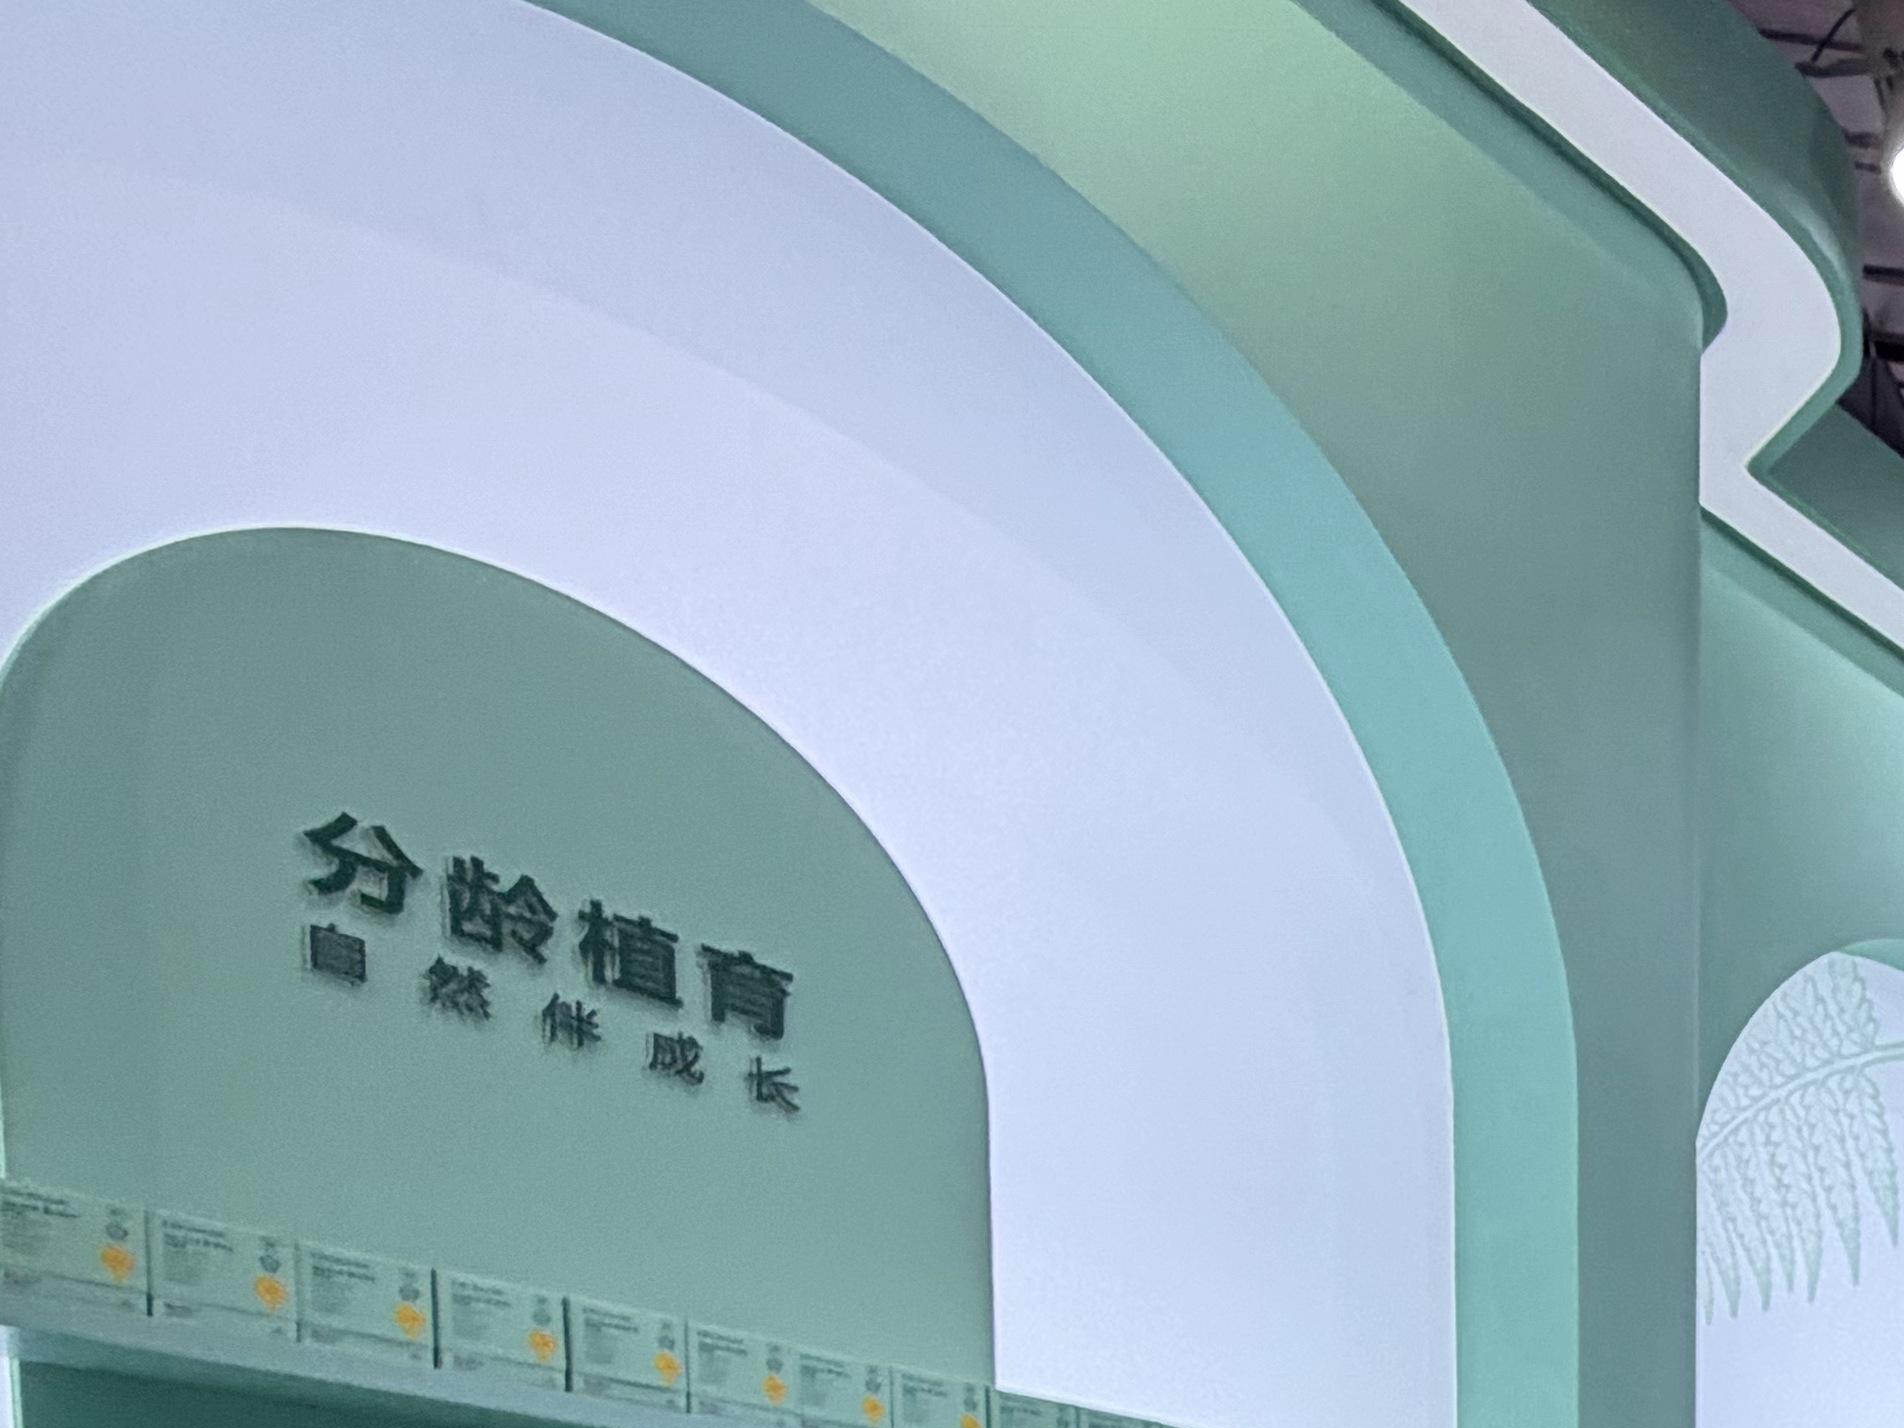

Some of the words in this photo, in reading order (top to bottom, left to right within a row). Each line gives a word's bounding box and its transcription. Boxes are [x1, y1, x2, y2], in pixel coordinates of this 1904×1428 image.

[302, 812, 795, 1040] 分龄植育
[303, 921, 802, 1114] 自然伴成长
